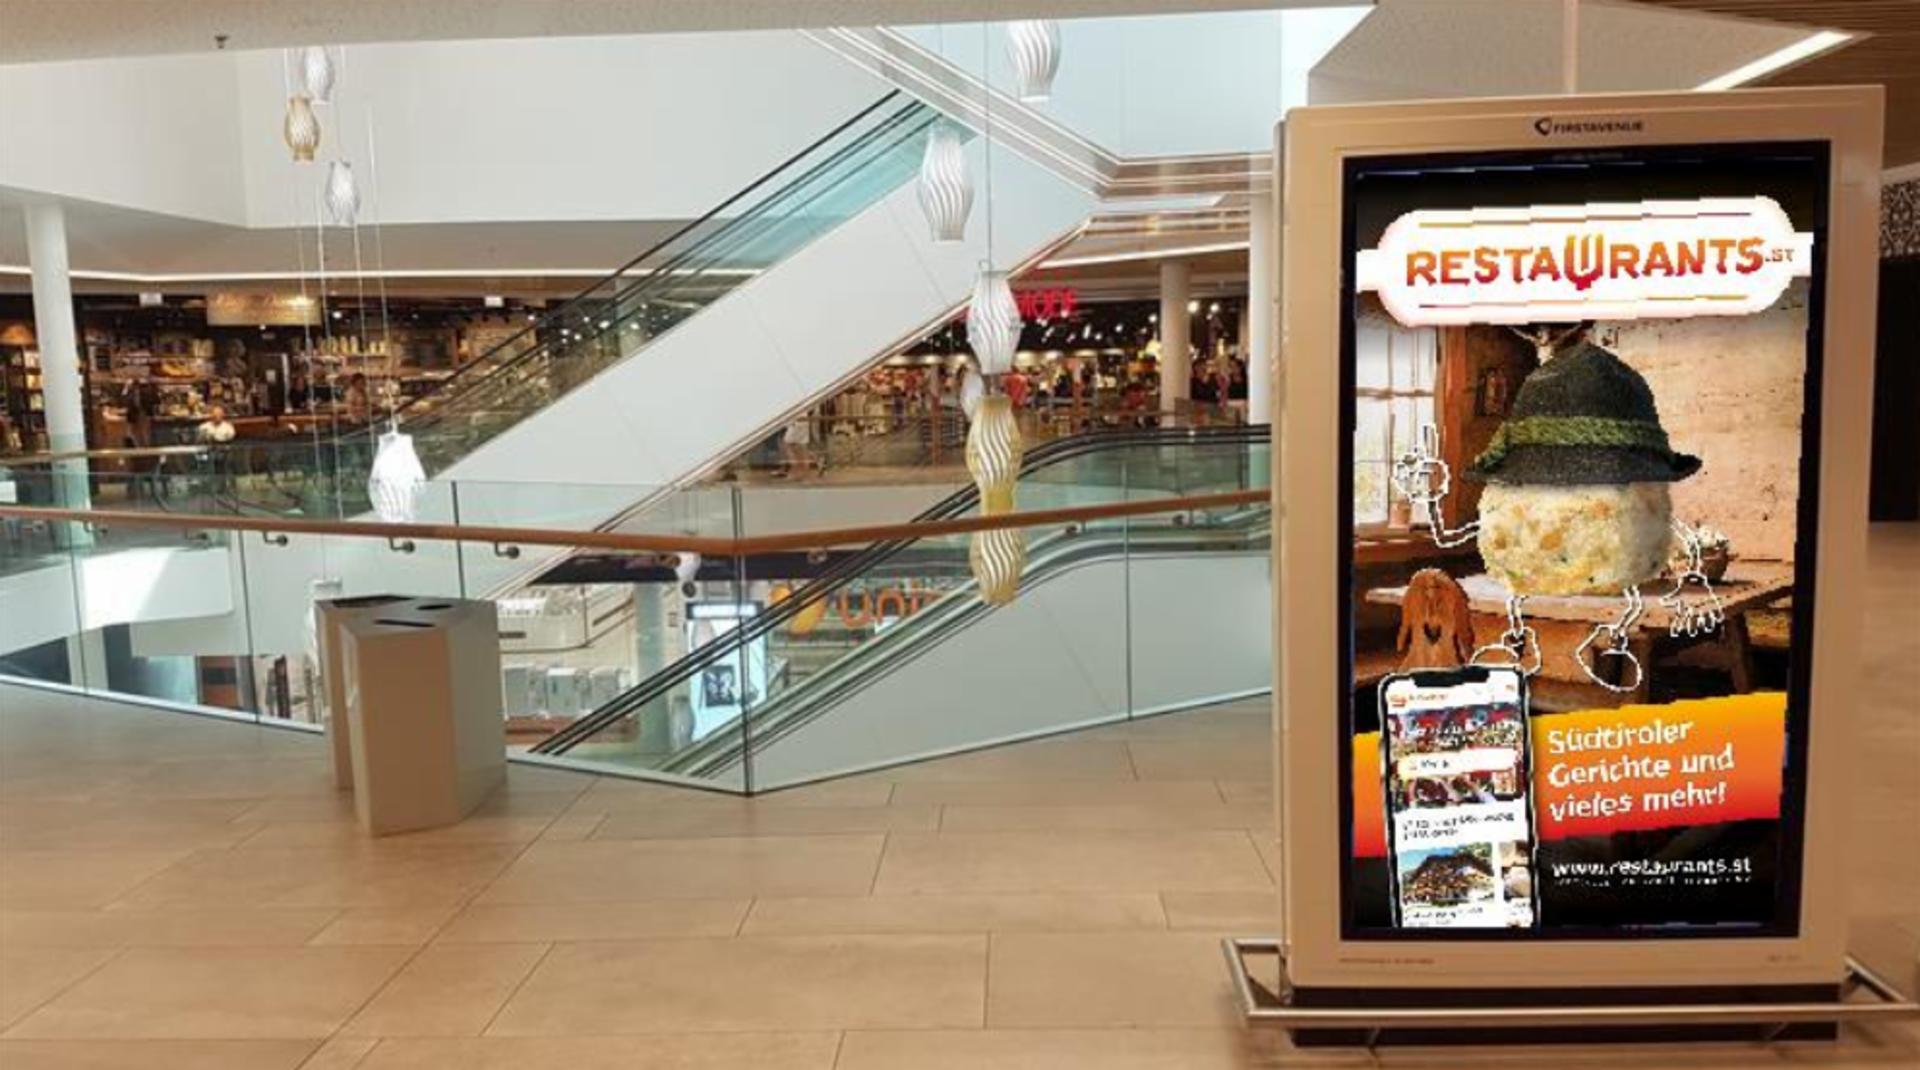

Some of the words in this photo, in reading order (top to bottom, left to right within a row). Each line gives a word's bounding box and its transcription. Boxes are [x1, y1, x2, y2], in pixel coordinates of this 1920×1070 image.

[1553, 120, 1644, 134] FIRSTAVENUE
[1547, 719, 1694, 754] Südtiroler
[1547, 754, 1671, 788] Gerichte
[1680, 742, 1735, 774] und
[1550, 791, 1633, 822] vieles
[1643, 781, 1727, 812] mehr!
[1551, 856, 1752, 878] www.restaurants.st
